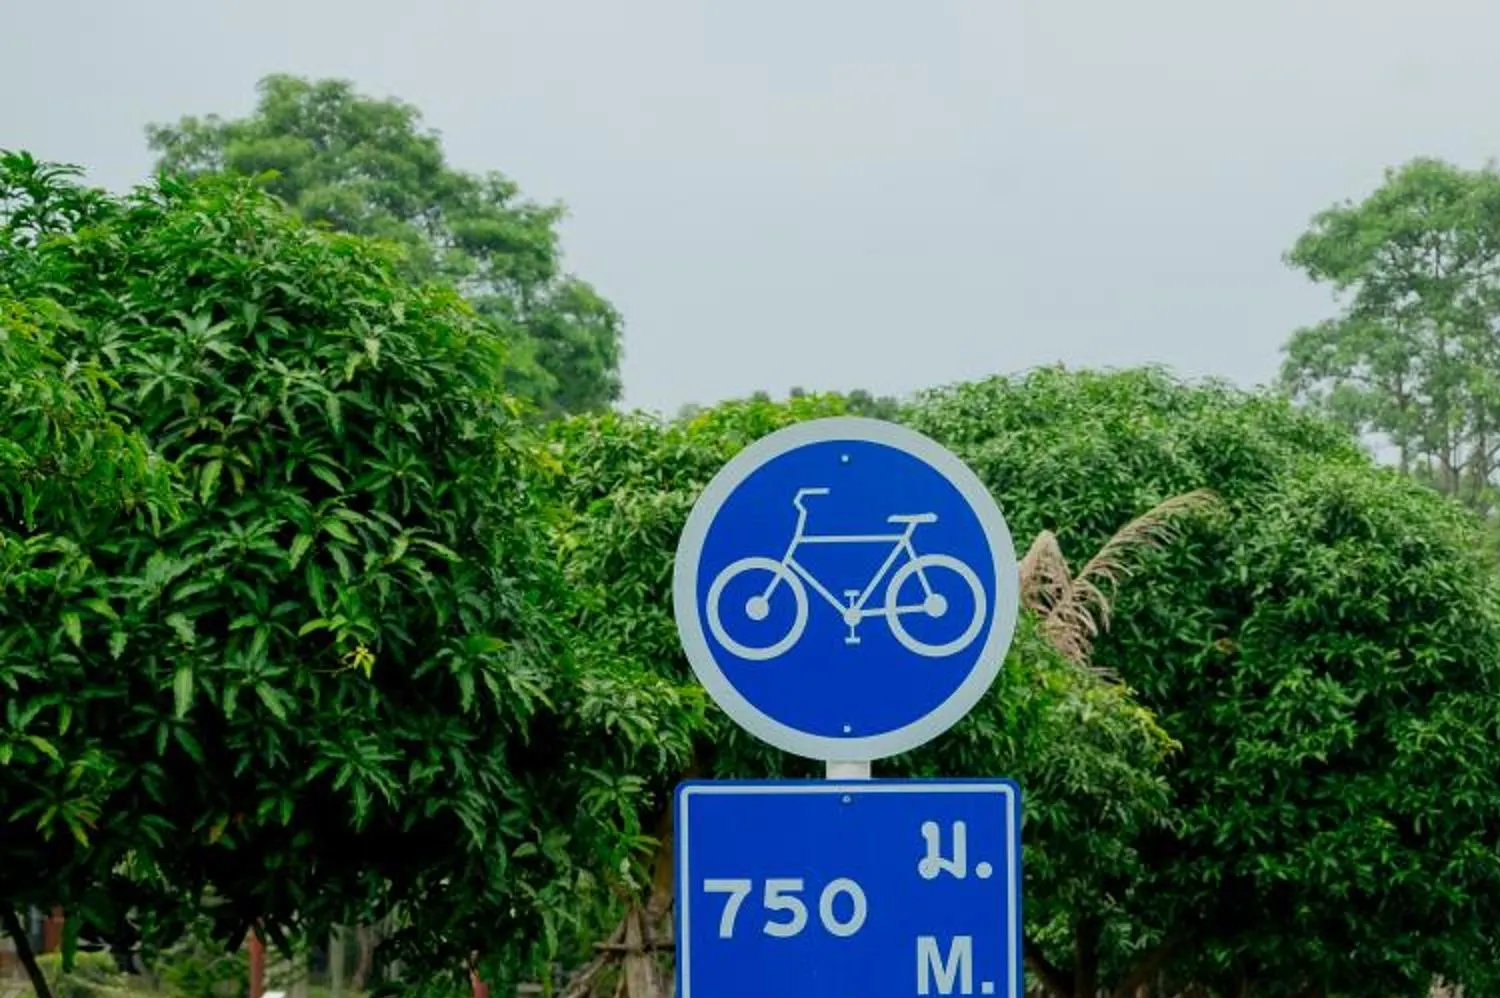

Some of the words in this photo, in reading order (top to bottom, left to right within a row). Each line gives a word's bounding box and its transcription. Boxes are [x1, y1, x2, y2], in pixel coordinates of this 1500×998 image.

[918, 820, 993, 879] ม.
[704, 877, 867, 938] 750
[917, 935, 994, 995] M.
